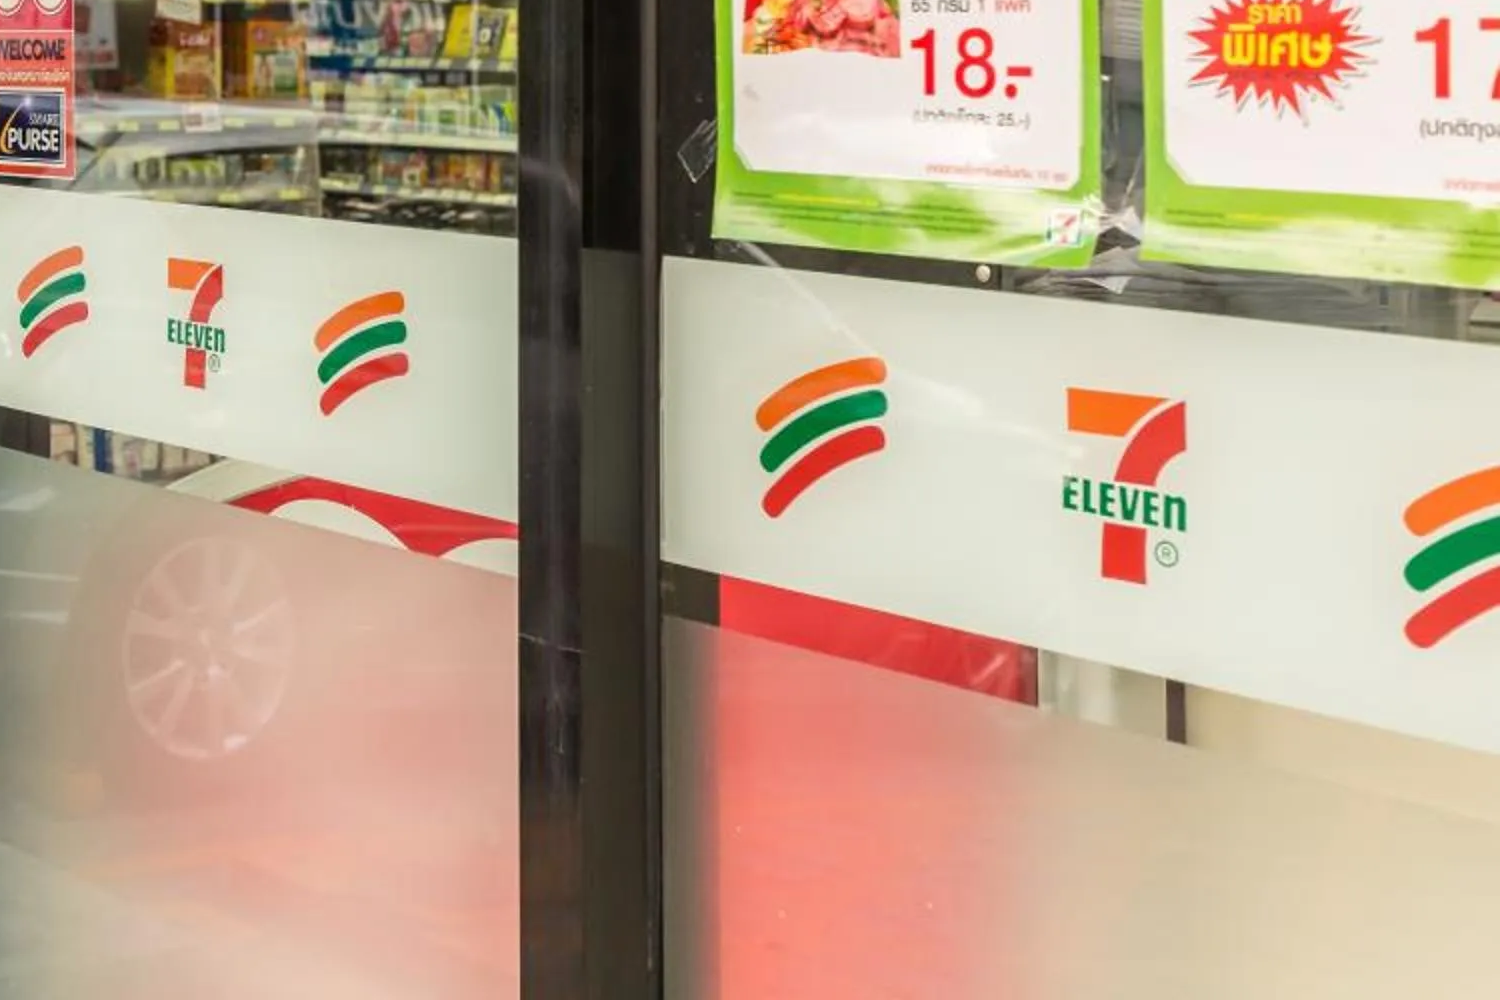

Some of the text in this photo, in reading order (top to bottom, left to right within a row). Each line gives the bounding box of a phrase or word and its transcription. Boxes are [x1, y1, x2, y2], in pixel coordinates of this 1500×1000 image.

[1248, 3, 1303, 25] ราคา
[910, 27, 1033, 99] 18.-
[1222, 23, 1333, 67] พิเศษ
[7, 127, 59, 152] PURSE
[167, 256, 224, 390] 7
[1066, 387, 1188, 585] 7
